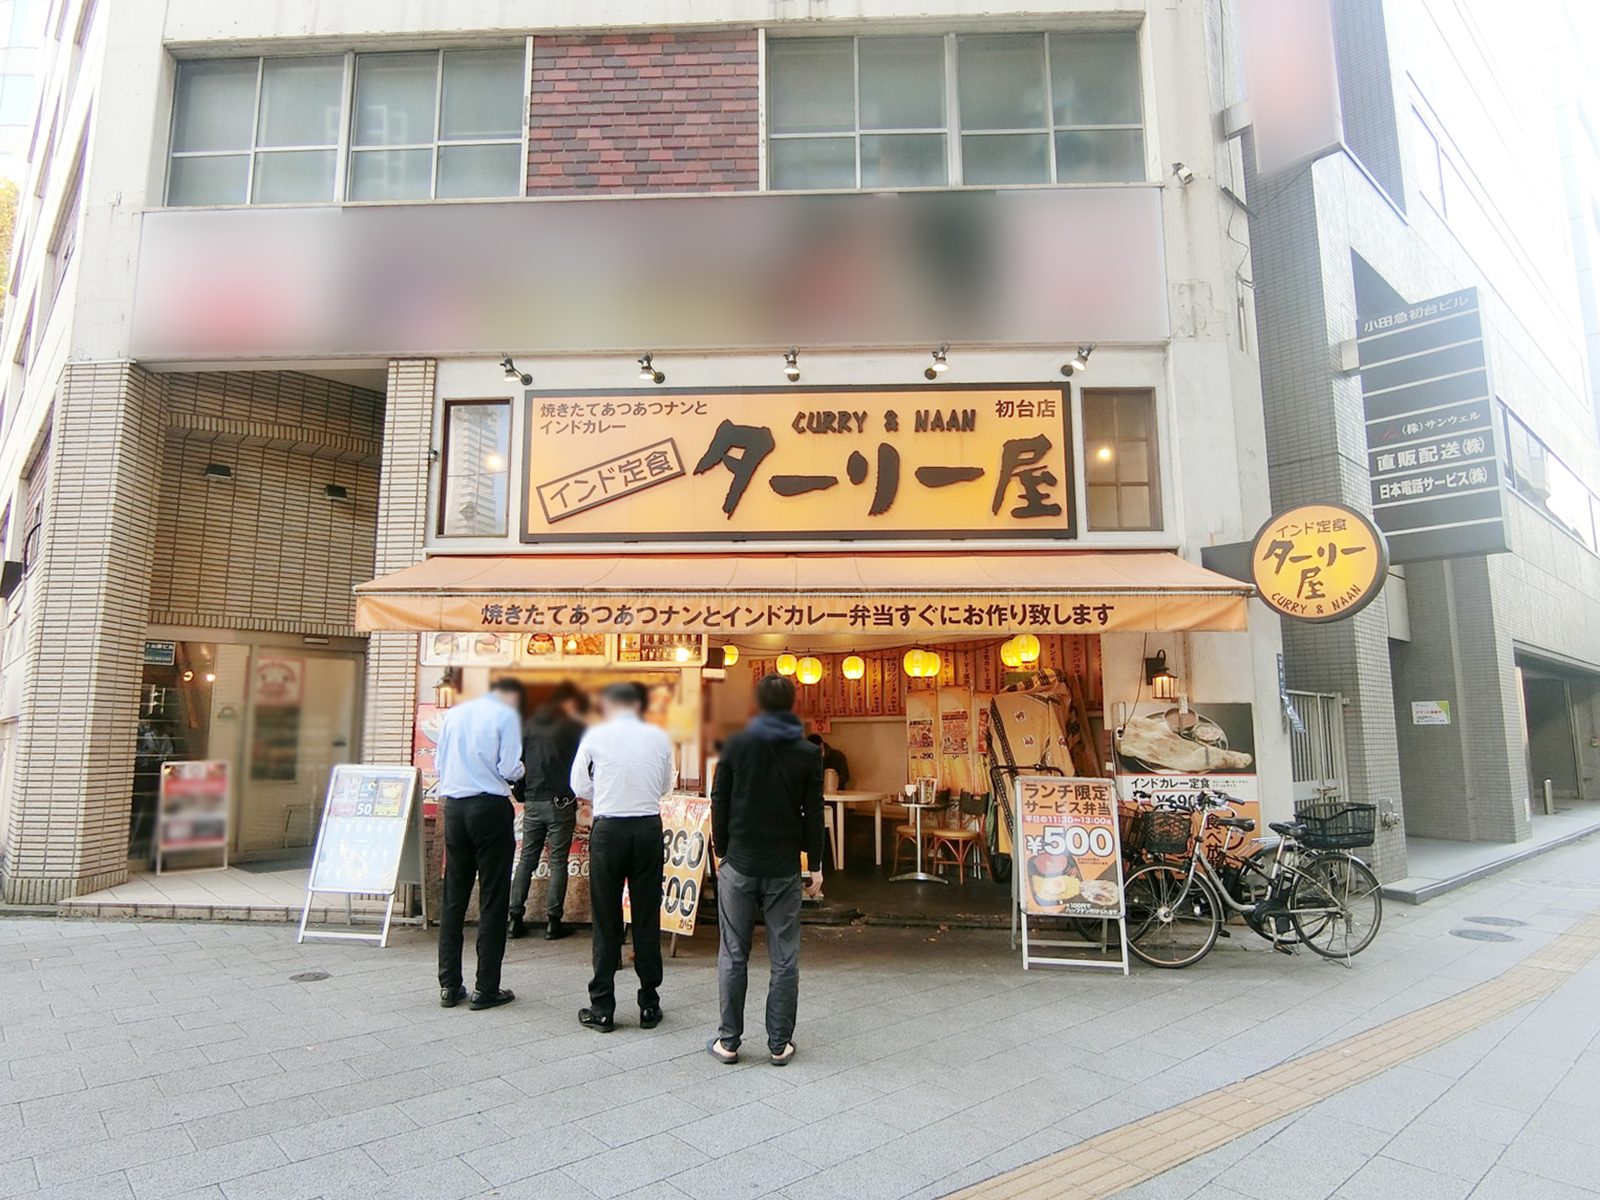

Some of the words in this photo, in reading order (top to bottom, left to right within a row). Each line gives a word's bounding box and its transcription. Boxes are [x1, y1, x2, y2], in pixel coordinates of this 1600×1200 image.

[1364, 296, 1468, 332] 小田急初台ビル
[540, 401, 707, 418] 焼きたてあつあつナンと
[995, 399, 1056, 418] 初台店
[540, 420, 626, 435] インドカレー
[791, 410, 868, 434] CURRY
[884, 409, 899, 433] &
[914, 409, 976, 433] NAAN
[550, 450, 674, 508] インド定食
[693, 419, 1062, 520] ターリー屋
[1276, 518, 1347, 538] インド定食
[1262, 539, 1367, 576] ターリー
[1296, 566, 1326, 600] 屋
[1271, 592, 1308, 614] CURRY
[1316, 604, 1324, 614] &
[1331, 584, 1362, 611] NAAN
[481, 603, 1115, 628] 焼きたてあつあつナンとインドカレー弁当すぐにお作り致します
[1025, 783, 1109, 801] ランチ限定
[1131, 778, 1210, 789] インドカレー定食
[1025, 801, 1111, 816] サービス弁当
[1025, 825, 1115, 857] ¥500
